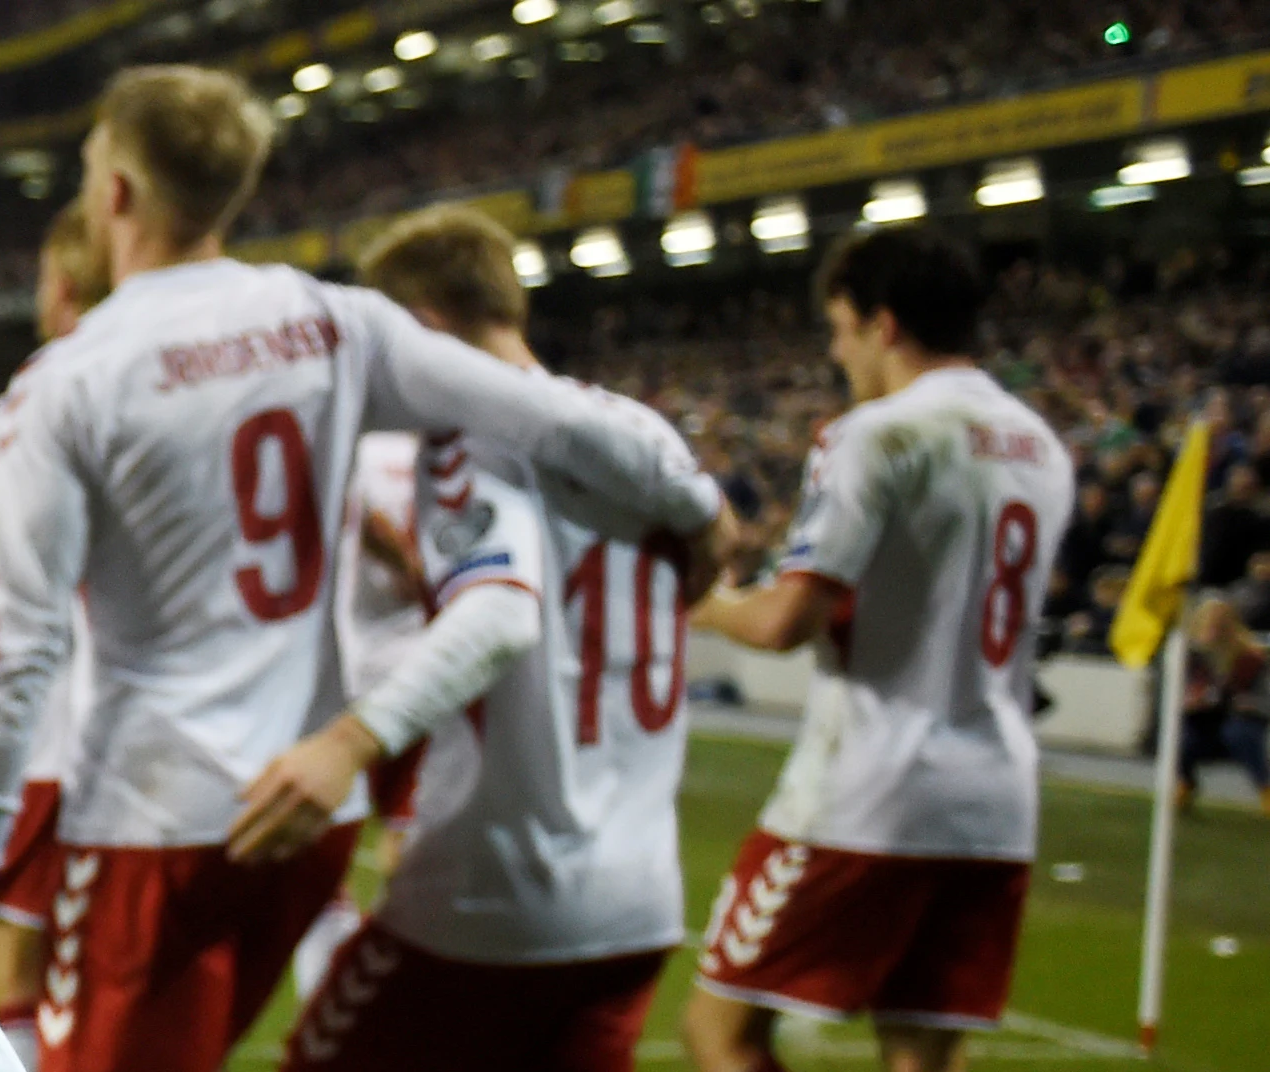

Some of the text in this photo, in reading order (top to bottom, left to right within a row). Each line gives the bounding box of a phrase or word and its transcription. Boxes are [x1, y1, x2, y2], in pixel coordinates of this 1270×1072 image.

[230, 407, 325, 624] 9
[980, 499, 1039, 668] 8
[564, 534, 689, 748] 10
